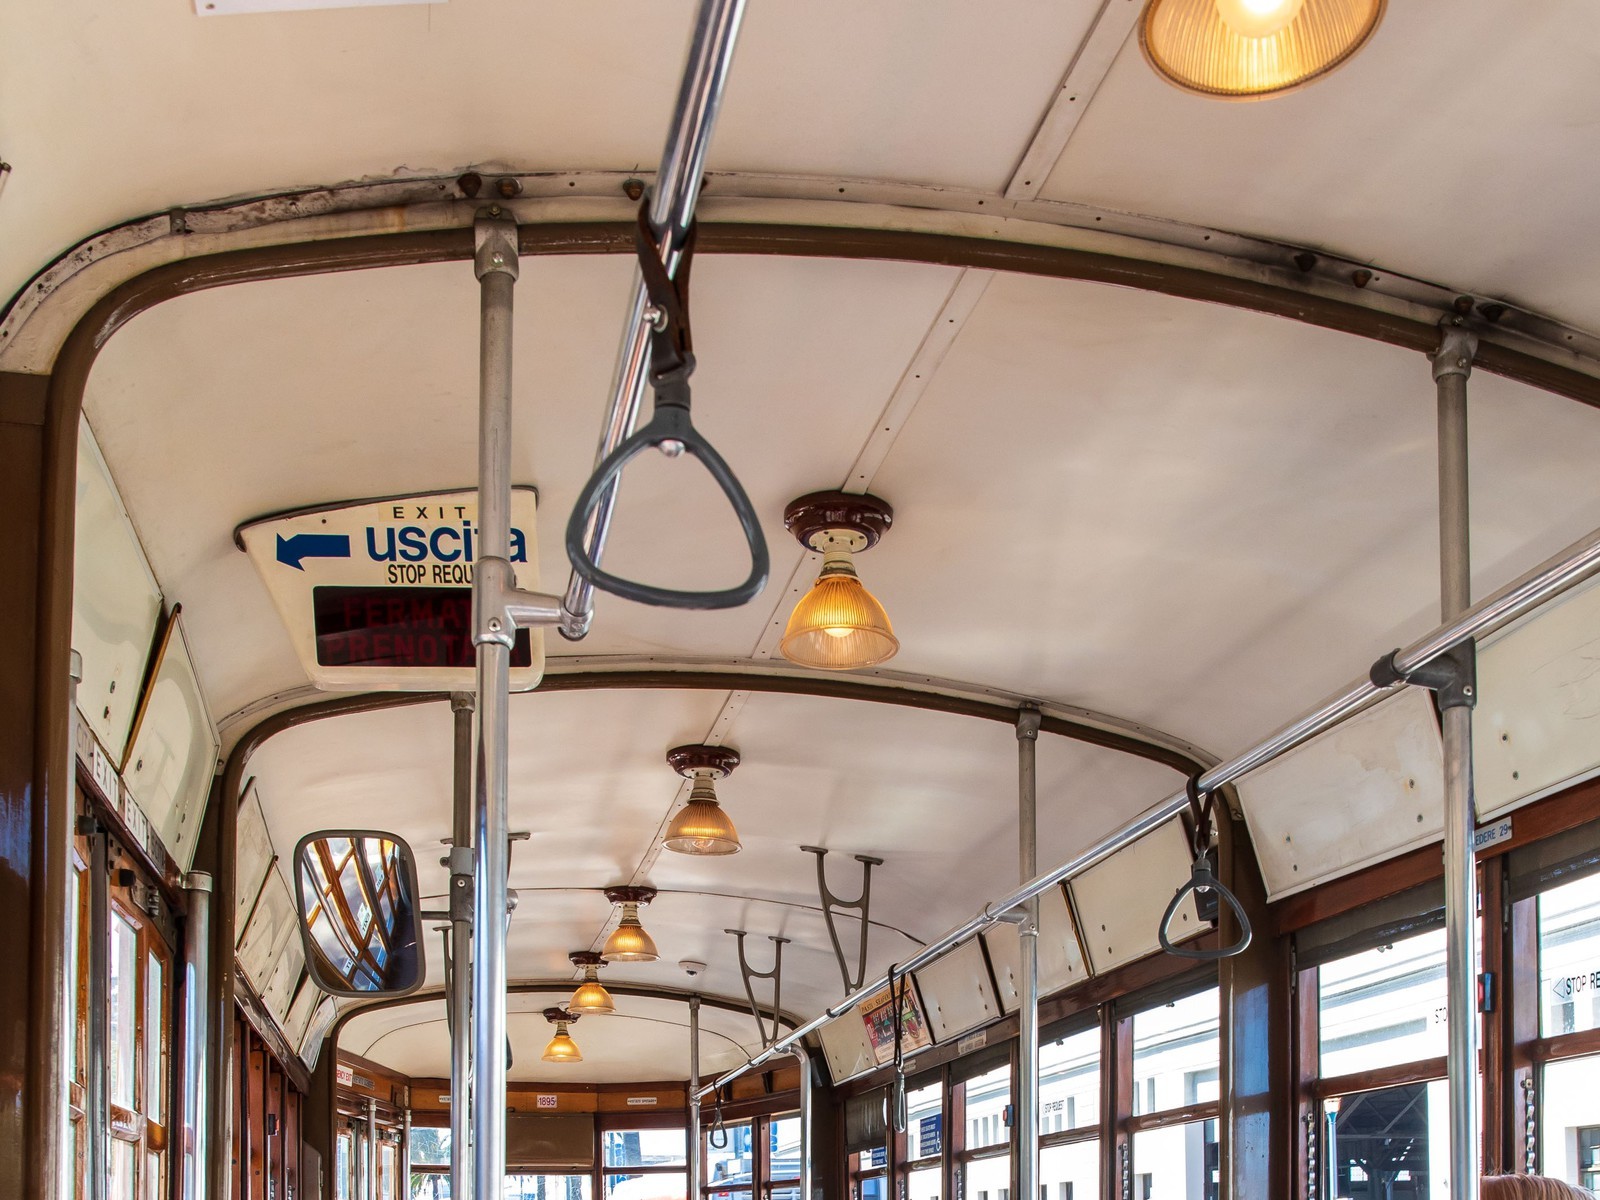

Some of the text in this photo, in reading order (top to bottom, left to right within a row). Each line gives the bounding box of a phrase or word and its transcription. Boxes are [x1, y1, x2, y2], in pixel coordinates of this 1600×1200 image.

[393, 506, 466, 519] EXIT
[366, 520, 528, 562] uscia
[388, 564, 474, 584] STOP REQU
[96, 750, 118, 804] EXIT
[127, 798, 146, 842] EXIT
[1475, 828, 1496, 846] EDERE
[1565, 975, 1587, 996] STOP
[539, 1096, 556, 1106] 1895
